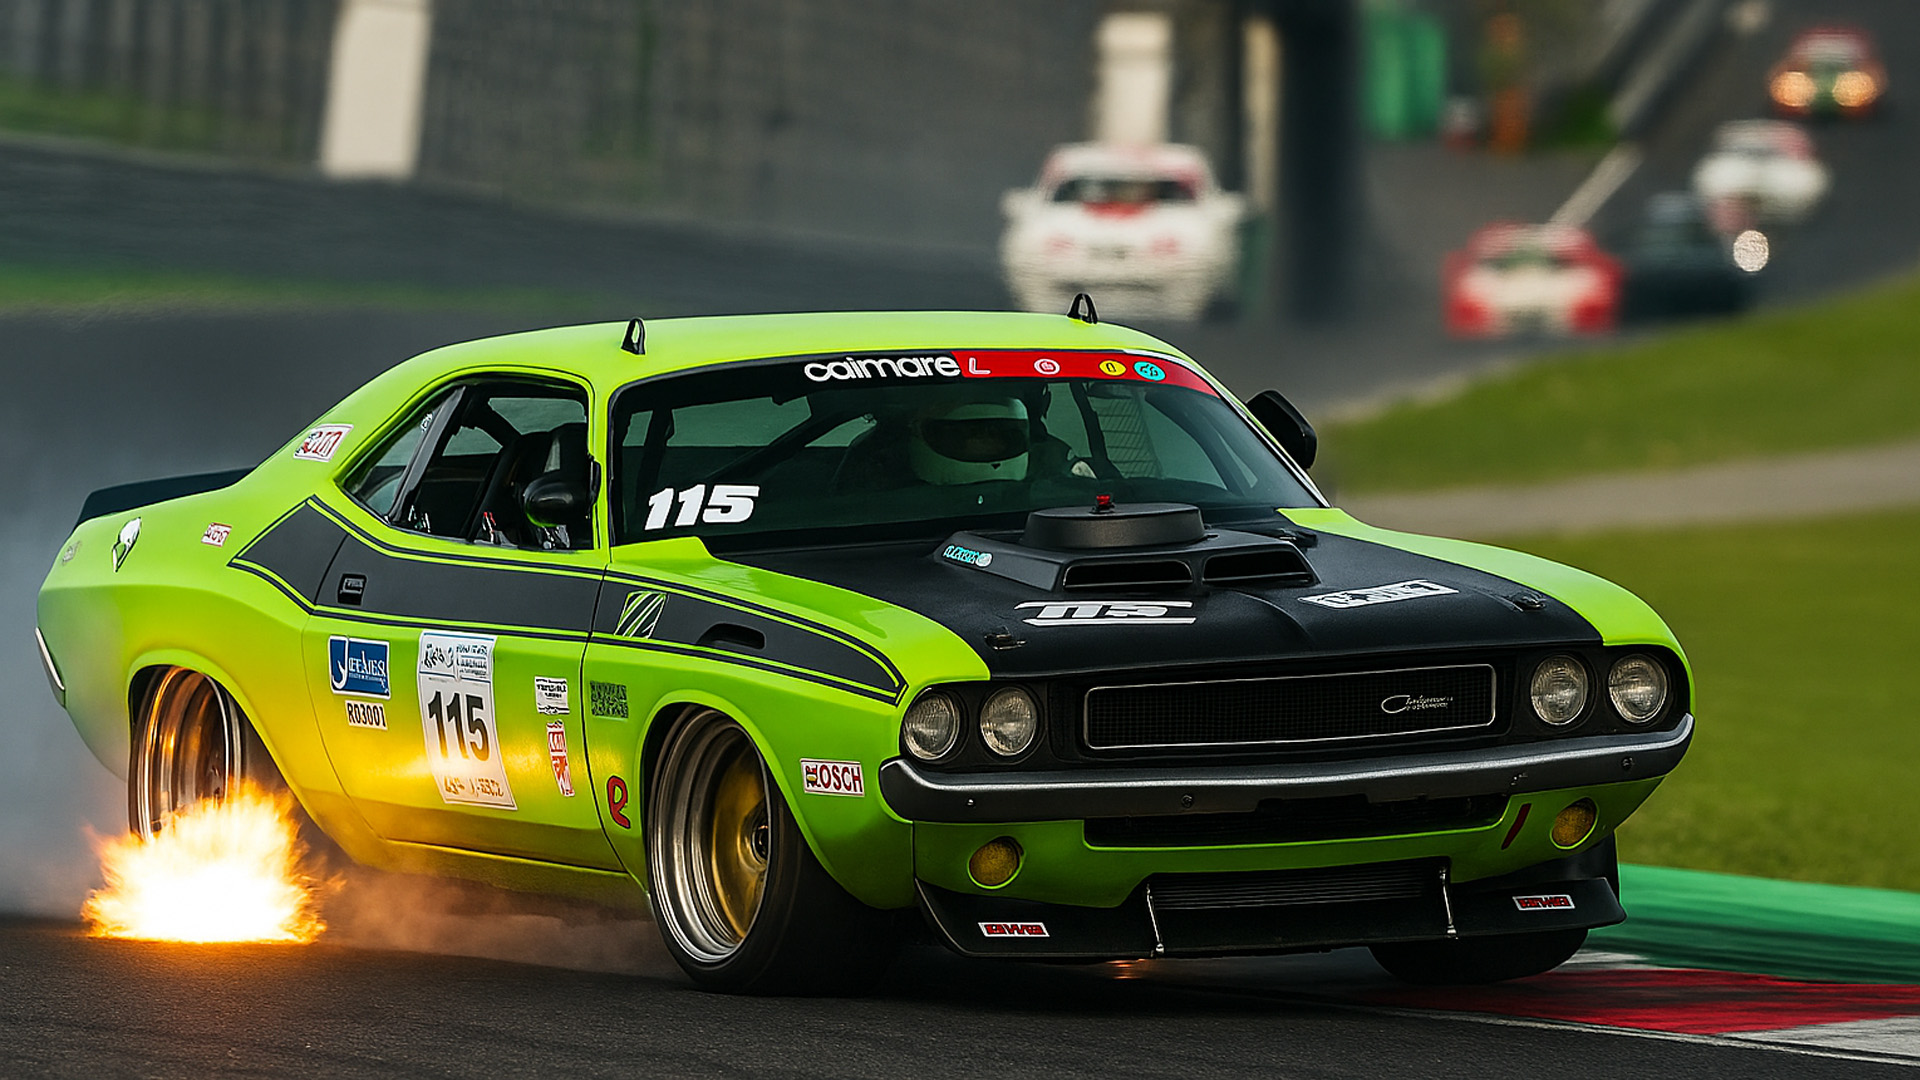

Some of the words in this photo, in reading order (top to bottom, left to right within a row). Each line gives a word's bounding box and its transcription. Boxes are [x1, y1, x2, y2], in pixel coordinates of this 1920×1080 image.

[804, 356, 961, 382] caimare
[644, 484, 760, 530] 115
[1035, 602, 1170, 621] 115
[347, 702, 386, 727] R03001
[428, 691, 490, 761] 115
